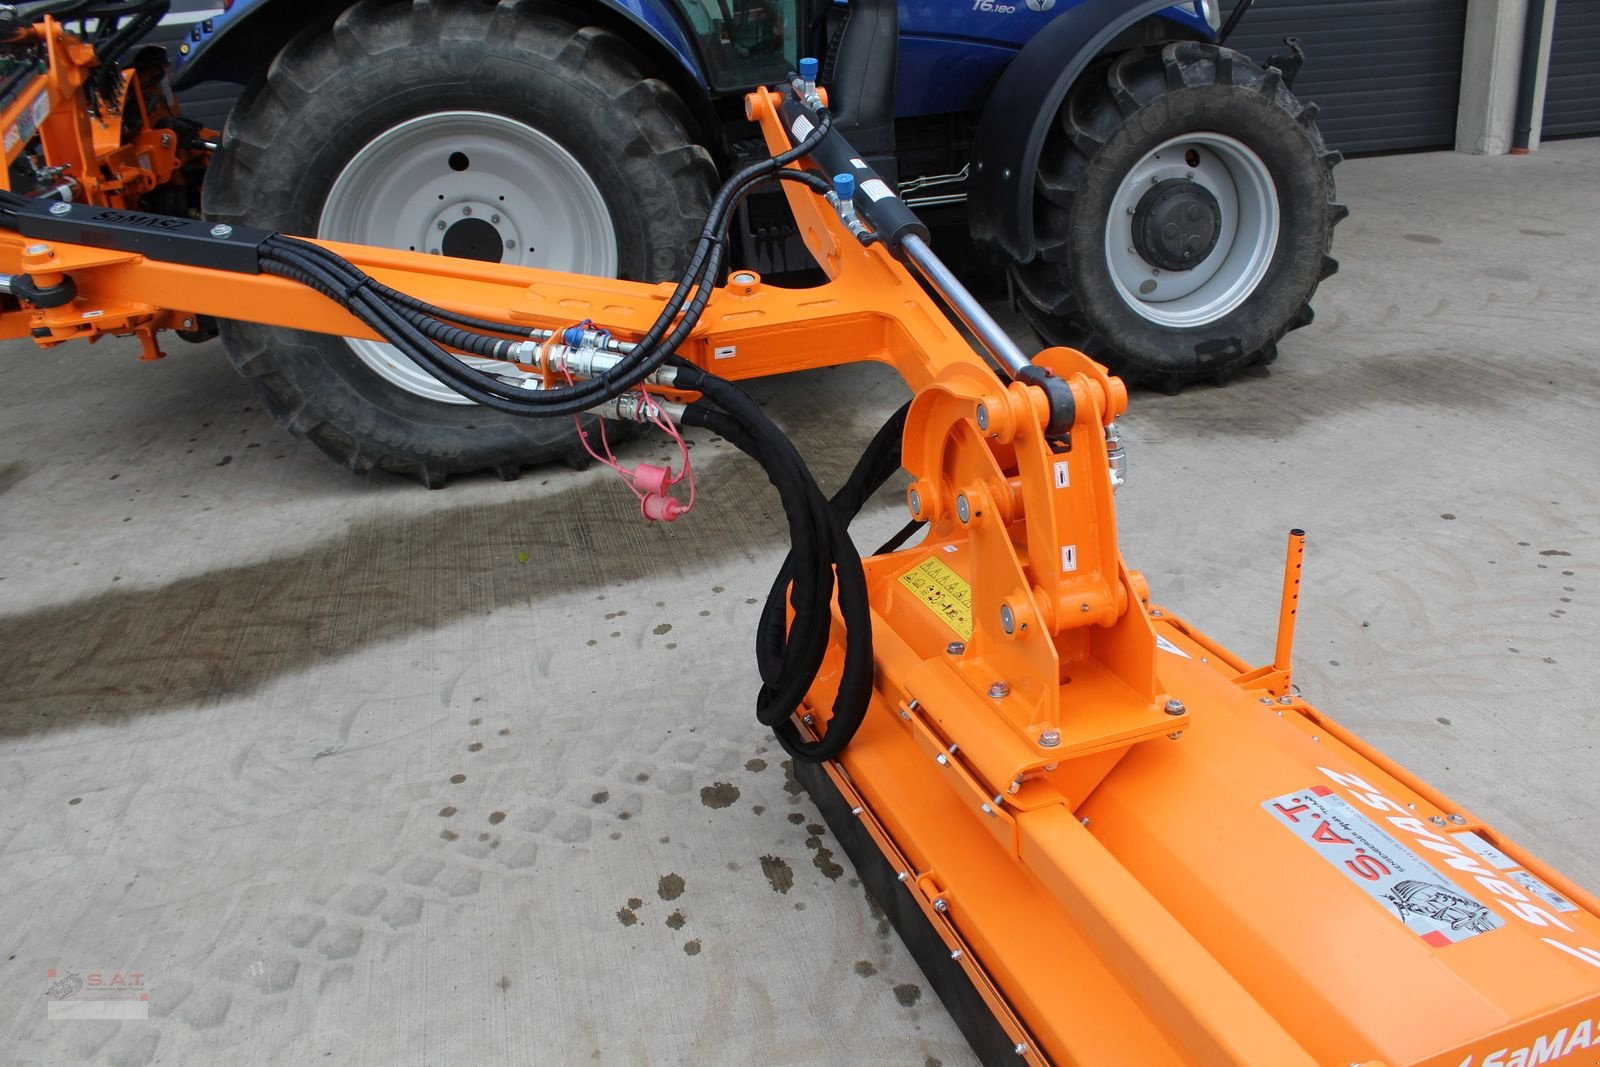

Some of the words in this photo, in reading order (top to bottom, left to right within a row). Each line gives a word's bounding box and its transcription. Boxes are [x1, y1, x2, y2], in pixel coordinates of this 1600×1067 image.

[972, 0, 1015, 14] T6.180
[1272, 798, 1392, 881] S.A.T.
[1316, 766, 1575, 933] SaMASZ
[1481, 1018, 1600, 1067] SaMA
